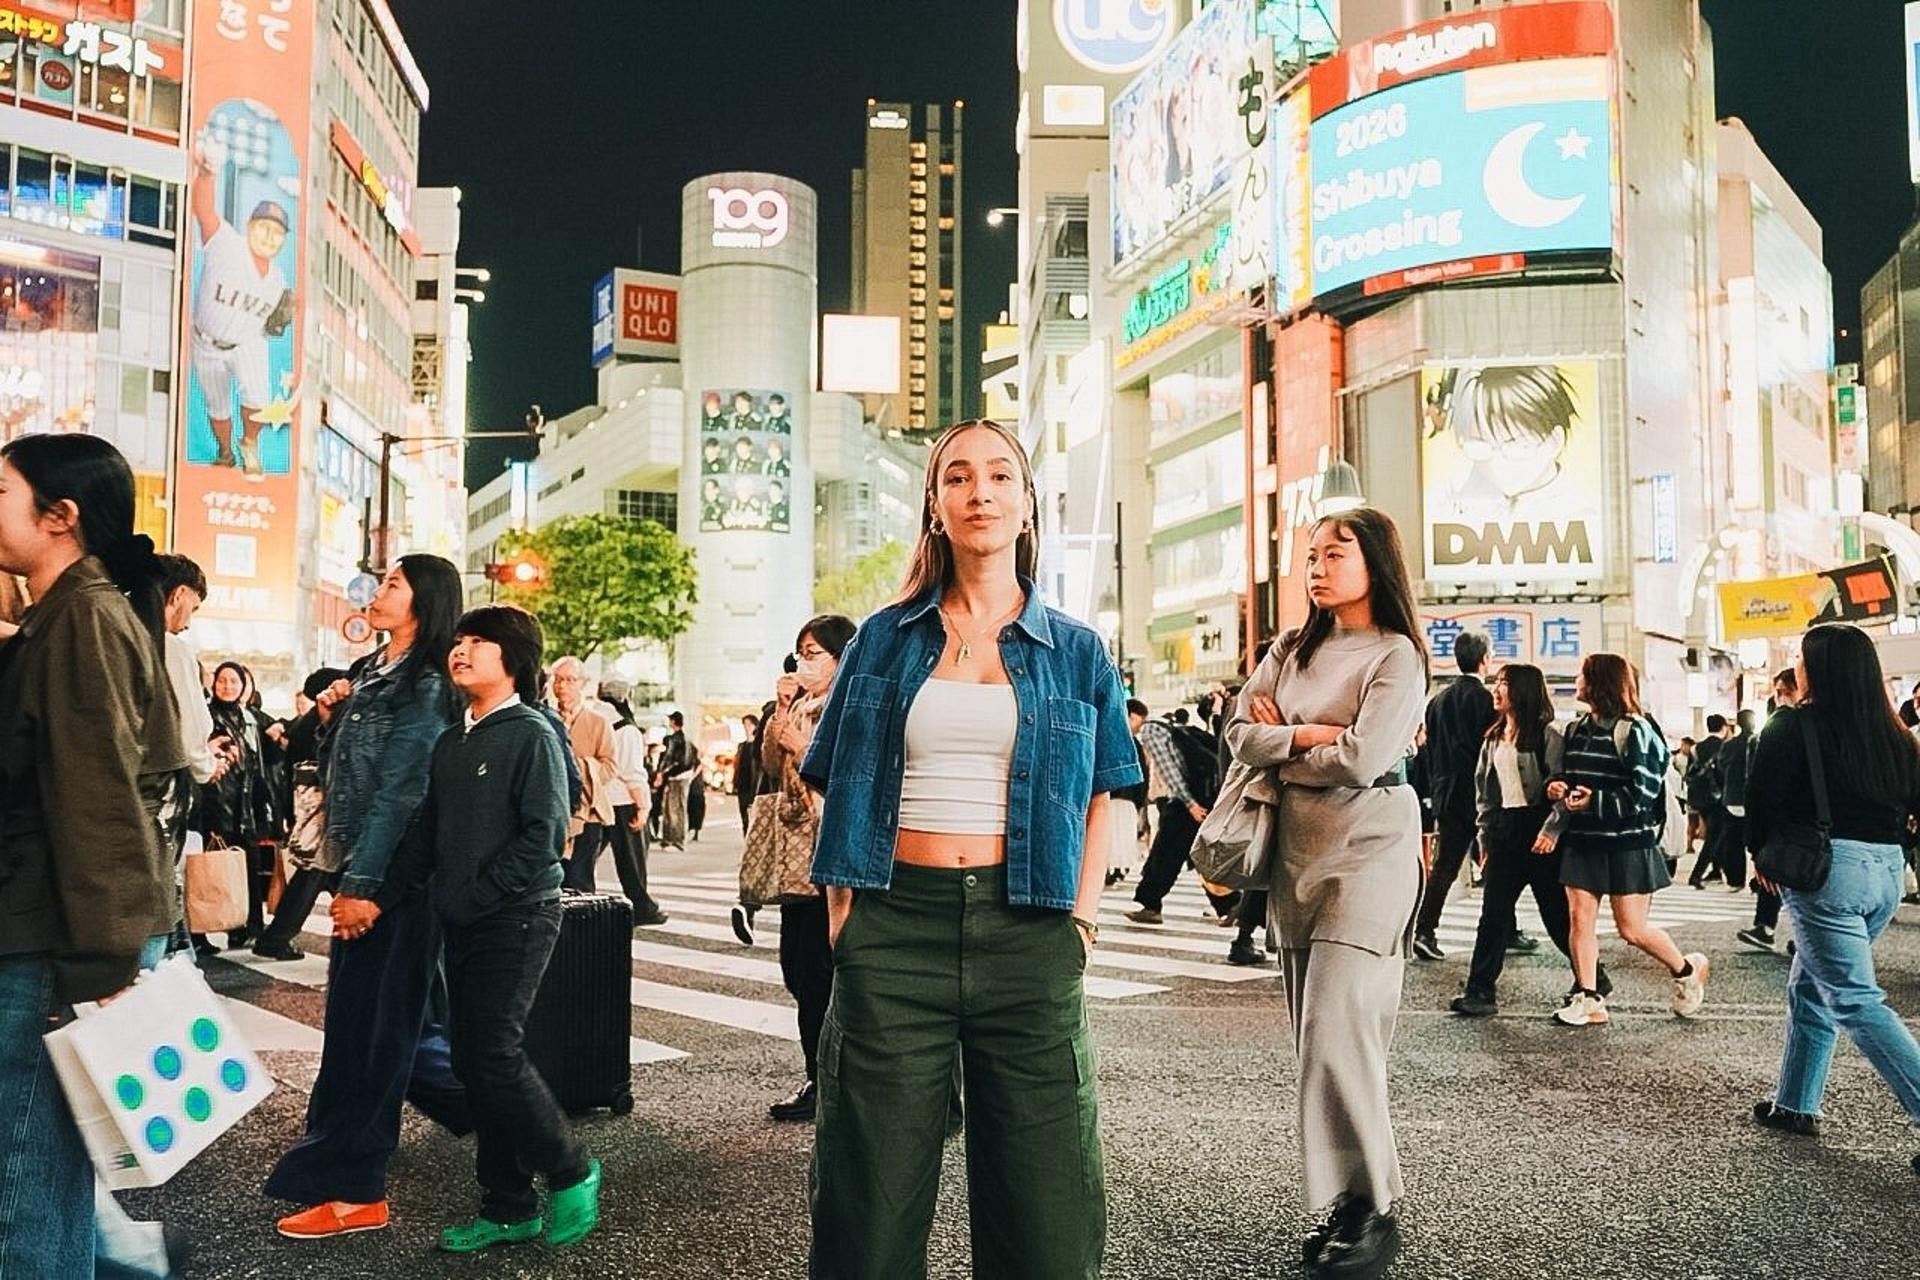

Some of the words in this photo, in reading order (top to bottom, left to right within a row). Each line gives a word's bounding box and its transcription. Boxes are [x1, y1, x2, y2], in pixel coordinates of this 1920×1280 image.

[63, 20, 165, 77] ガスト
[1374, 22, 1497, 74] Rakuten
[1336, 103, 1406, 158] 2026
[1313, 159, 1443, 222] Shibuya
[707, 187, 789, 248] 109
[1314, 208, 1464, 273] Crossing
[629, 290, 669, 315] UNI
[629, 314, 671, 337] QLO
[1432, 520, 1593, 565] DMM
[1427, 617, 1581, 657] 堂書店
